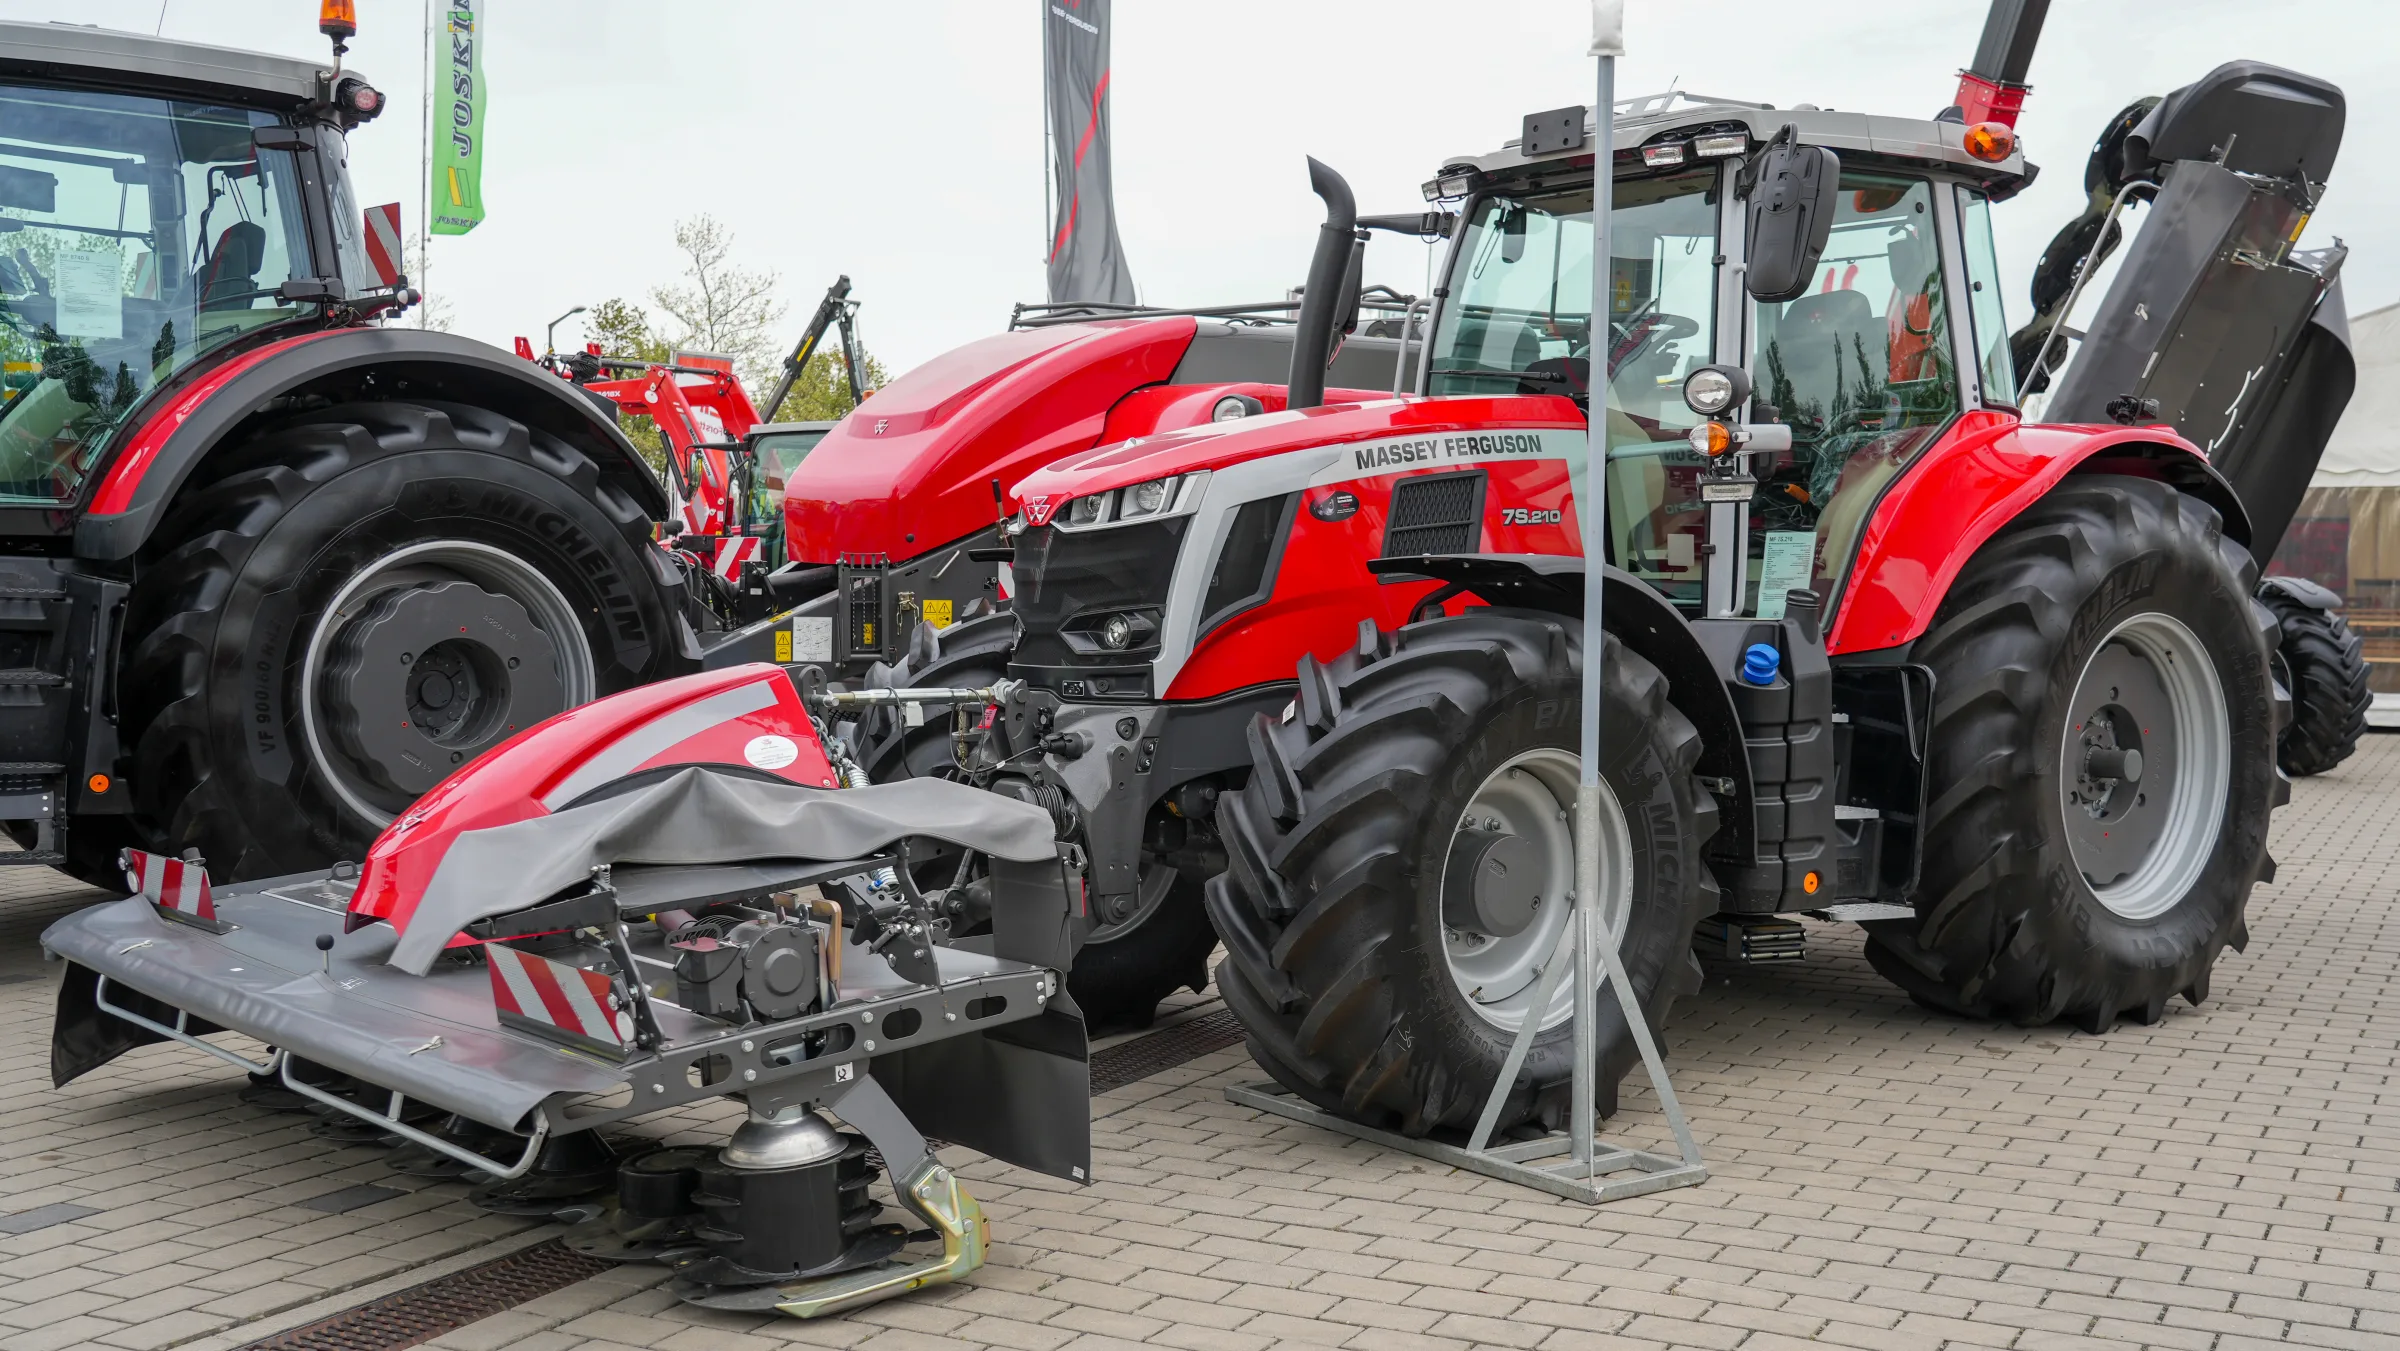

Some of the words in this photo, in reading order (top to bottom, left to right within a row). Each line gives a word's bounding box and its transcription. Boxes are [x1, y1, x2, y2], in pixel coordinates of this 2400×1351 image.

[1355, 439, 1439, 470] MASSEY
[1444, 434, 1543, 457] FERGUSON
[1502, 508, 1562, 526] 7S.210
[476, 486, 646, 642] MICHELIN
[257, 729, 277, 755] VF
